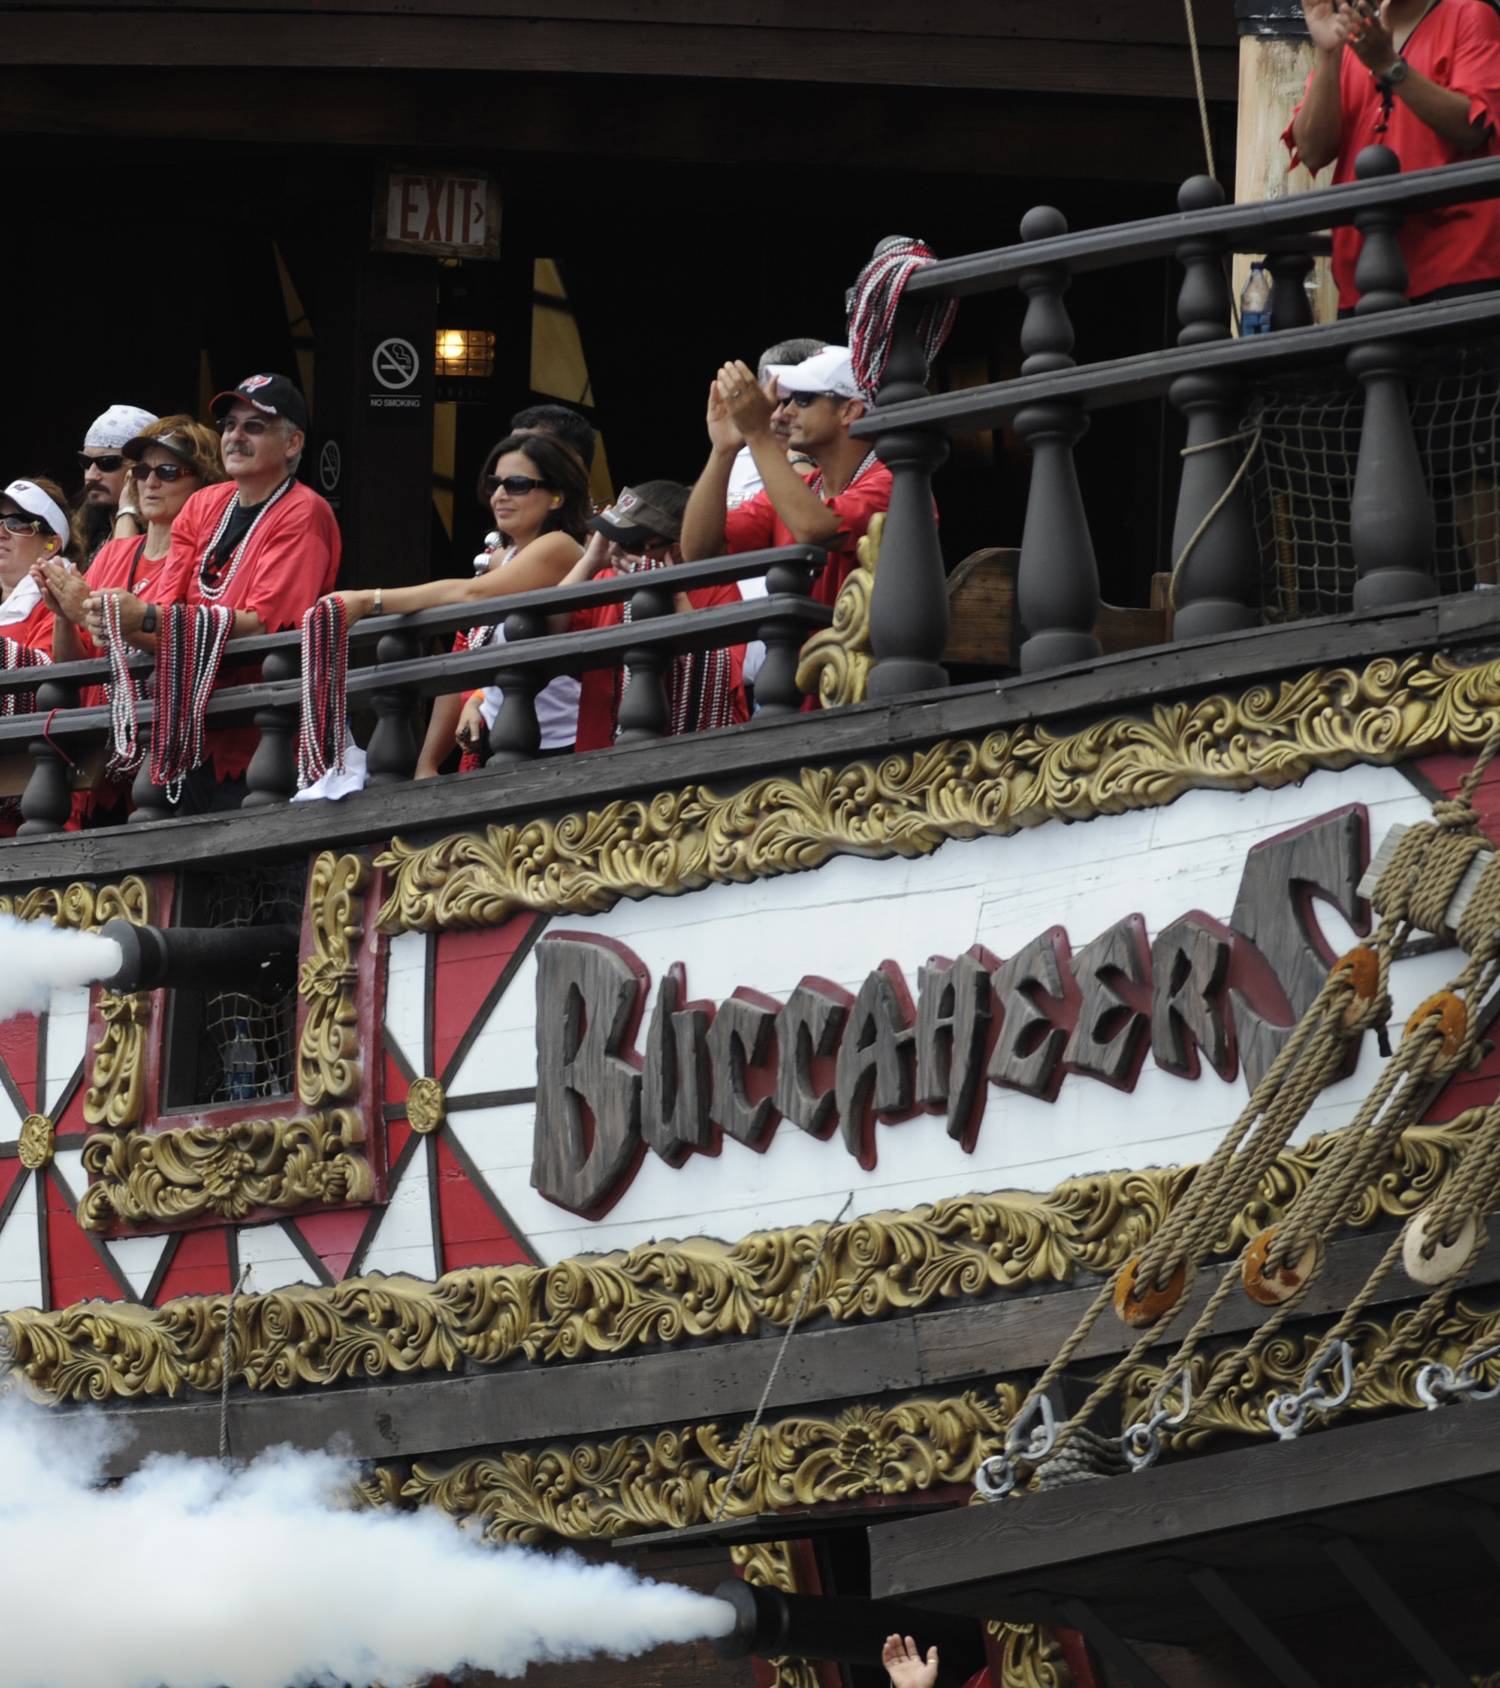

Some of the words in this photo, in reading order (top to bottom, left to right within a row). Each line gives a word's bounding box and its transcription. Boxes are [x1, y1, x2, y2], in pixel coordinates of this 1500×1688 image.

[399, 176, 479, 244] EXIT
[370, 399, 383, 407] NO
[383, 399, 421, 408] SMOKING
[531, 803, 1369, 1221] BUCCANEERS
